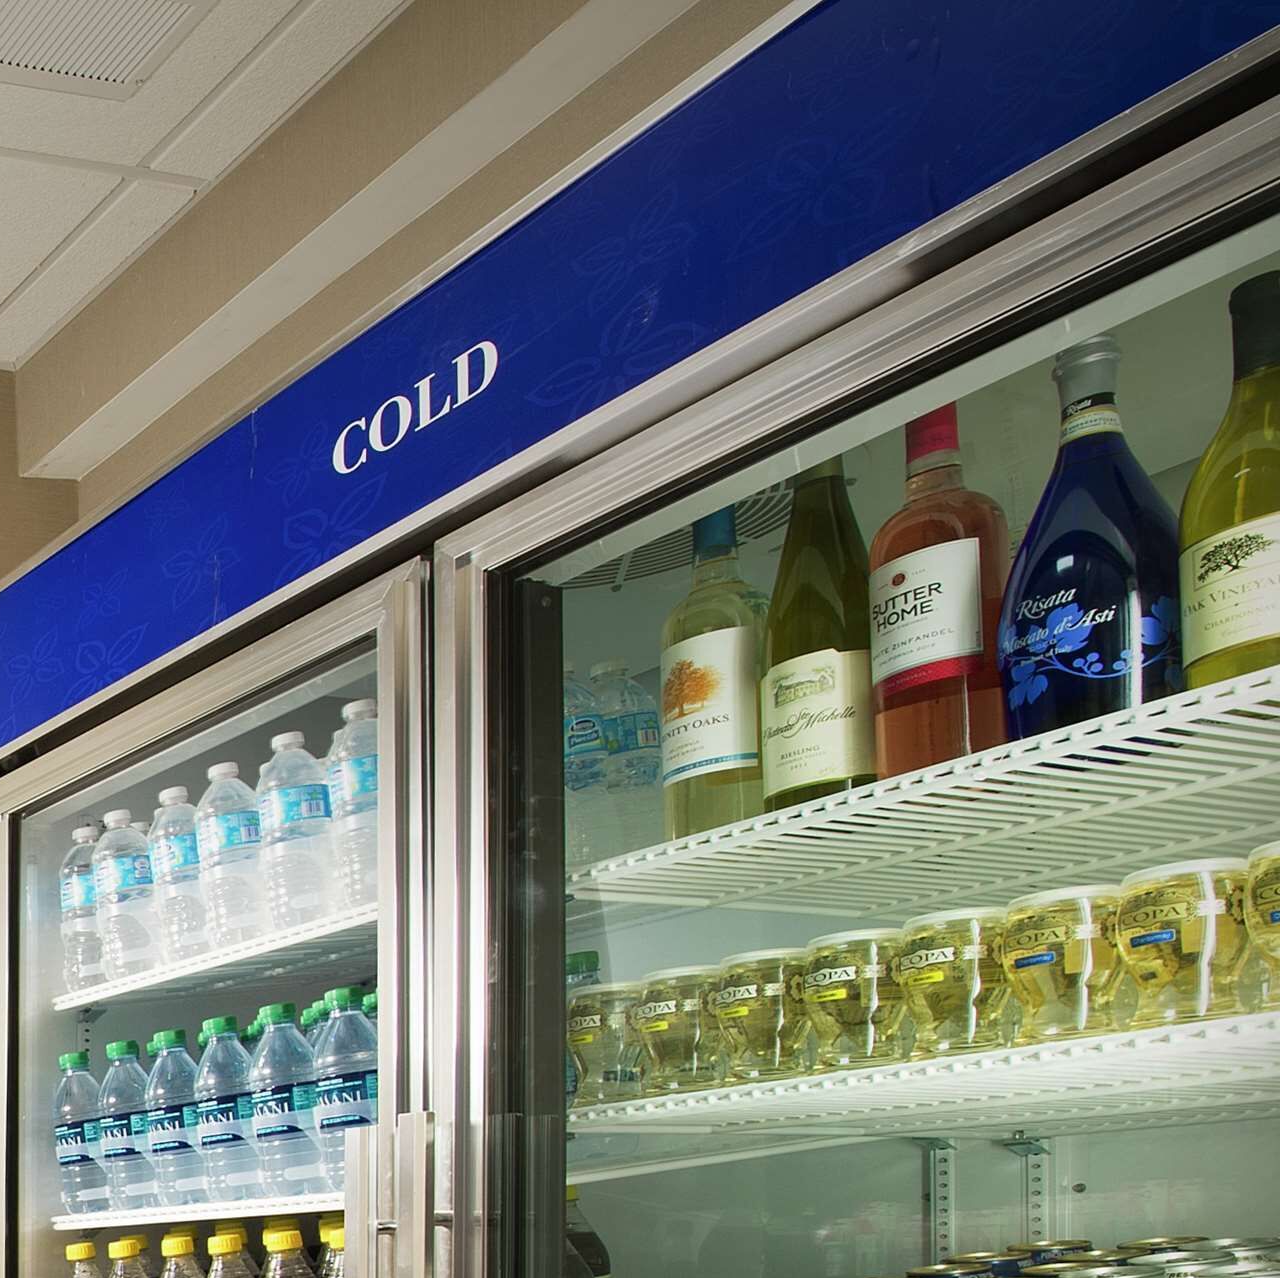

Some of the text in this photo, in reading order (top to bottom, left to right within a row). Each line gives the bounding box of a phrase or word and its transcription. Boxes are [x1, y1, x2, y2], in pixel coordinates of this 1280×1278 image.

[332, 340, 498, 474] COLD
[1209, 574, 1280, 602] VINEYA
[872, 582, 943, 620] SUTTER
[1016, 588, 1077, 621] Risata
[877, 599, 933, 633] HOME
[892, 627, 955, 651] ZINFANDEL
[692, 712, 730, 730] OAKS
[780, 745, 820, 760] RIESLING
[1121, 905, 1181, 926] COPA
[1006, 929, 1060, 948] COPA
[901, 950, 948, 969] COPA
[805, 968, 852, 985] COPA
[567, 1016, 599, 1031] OPA
